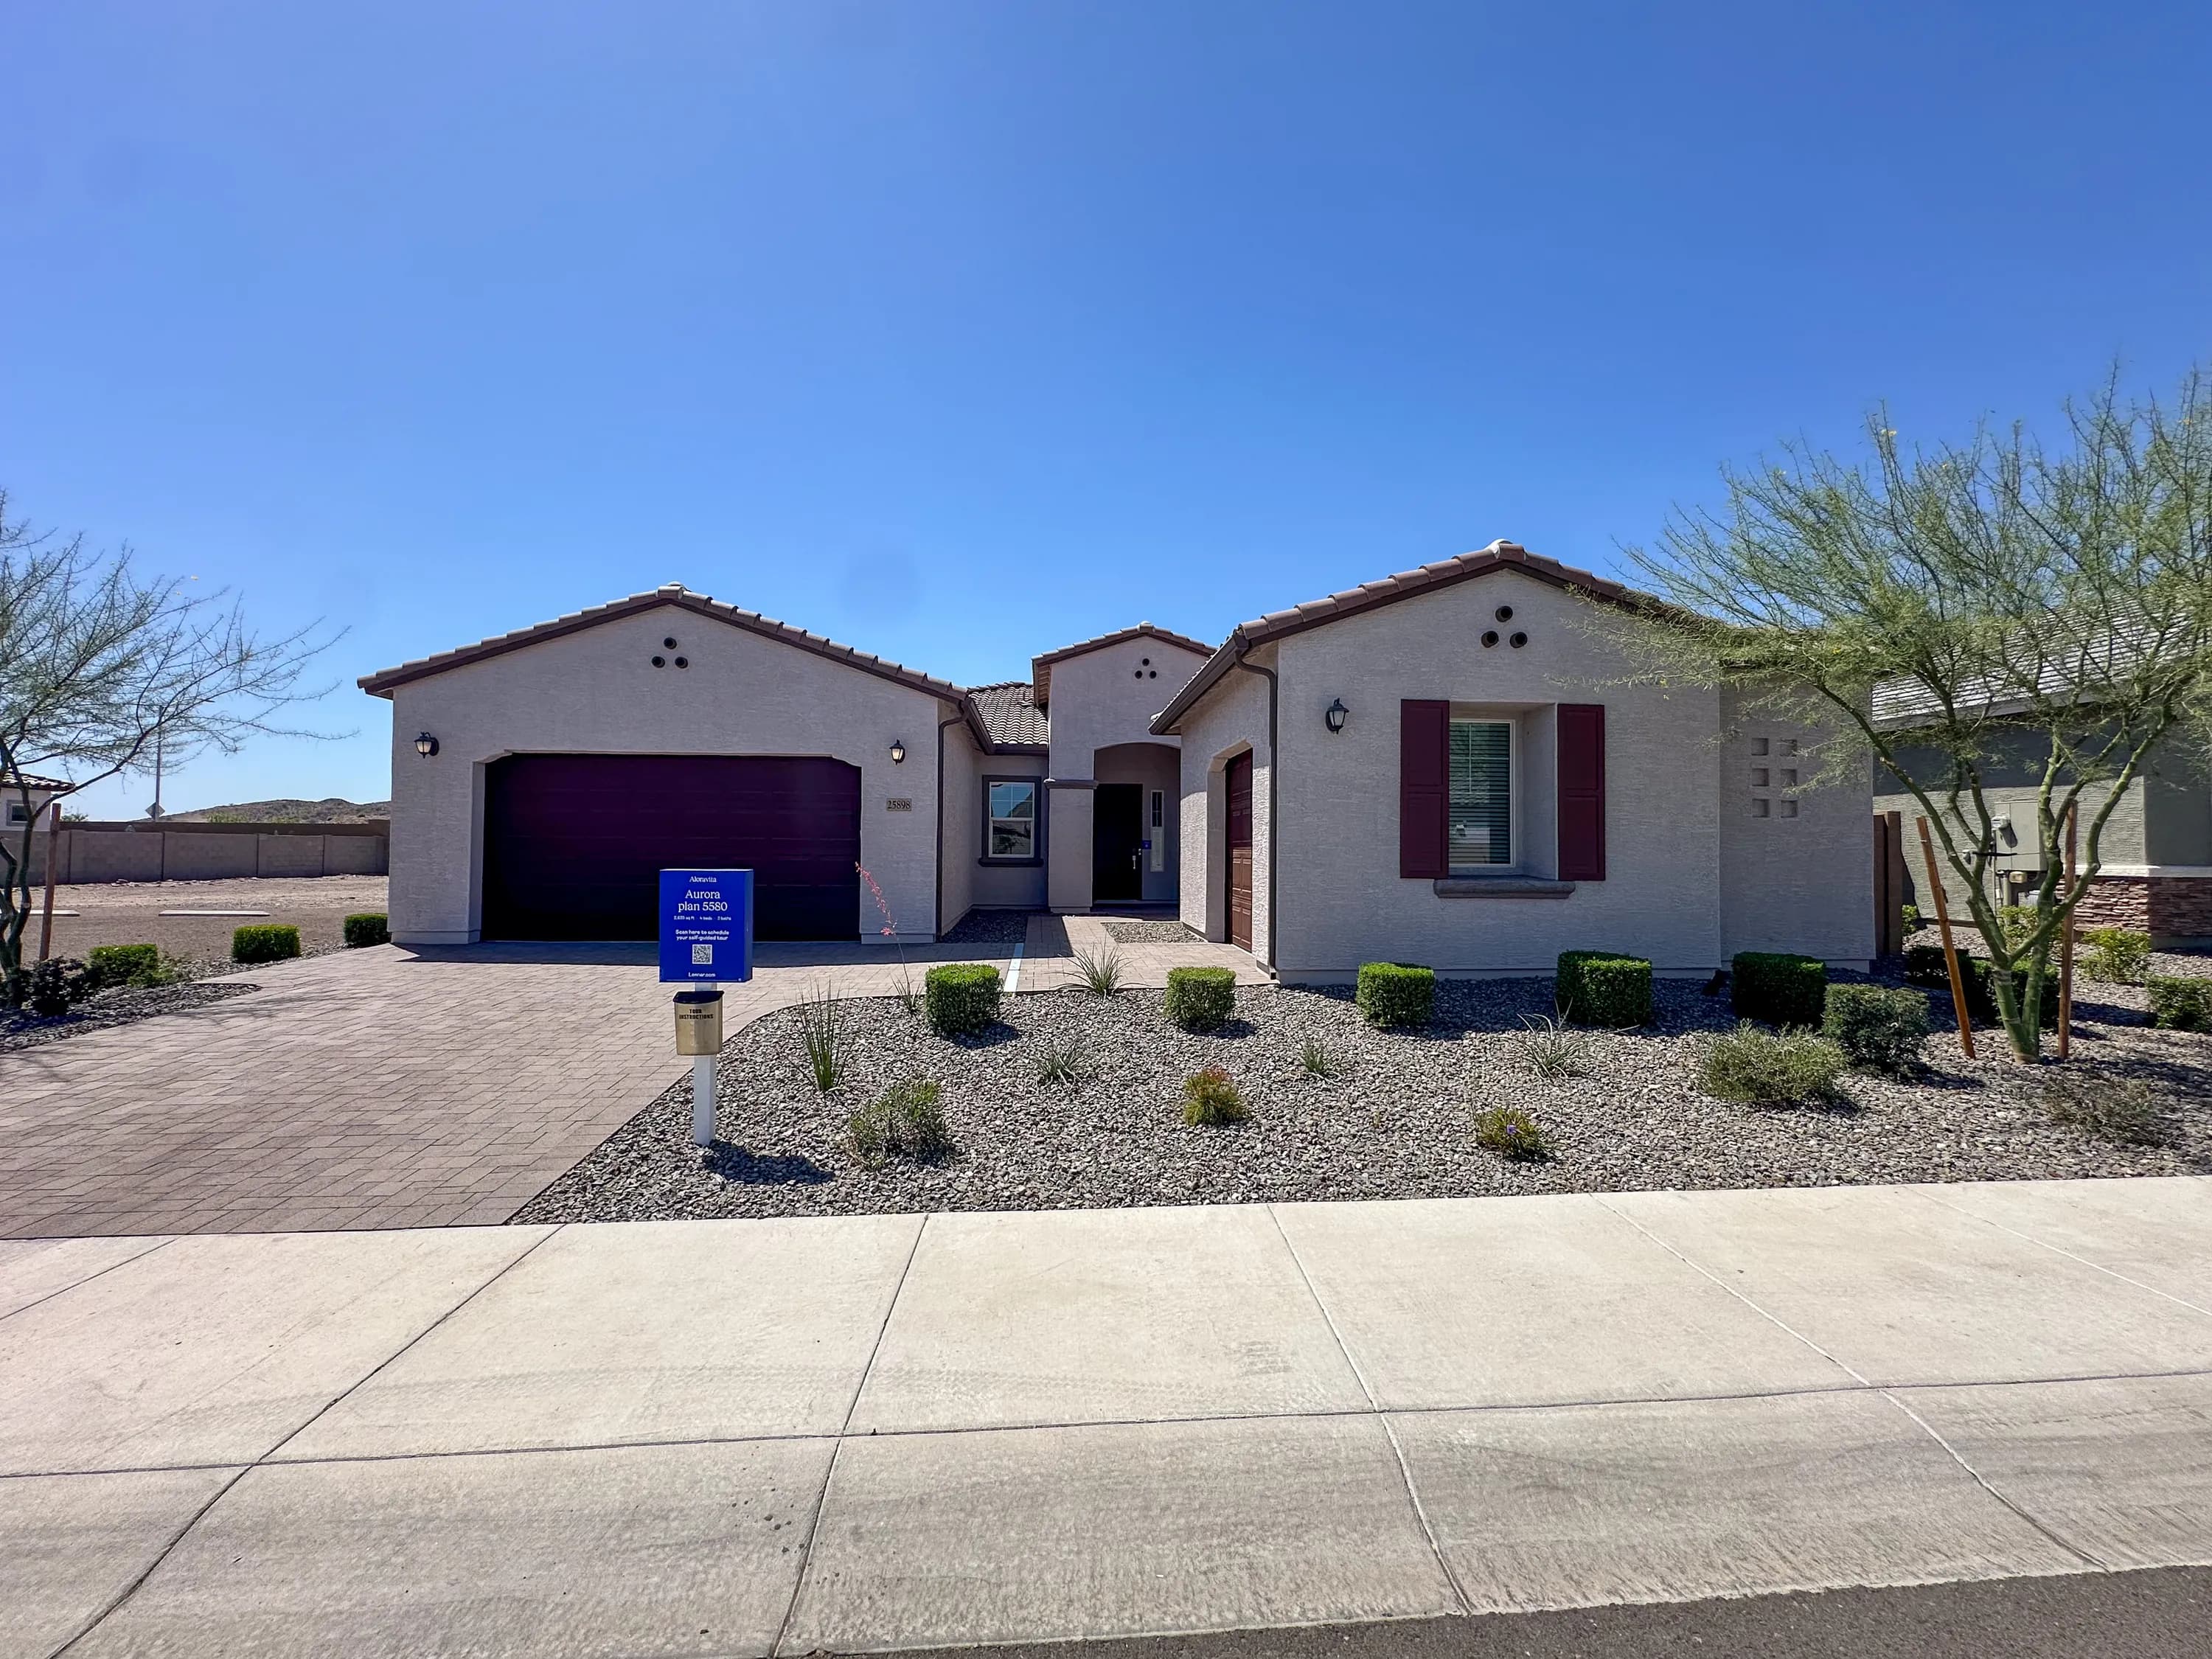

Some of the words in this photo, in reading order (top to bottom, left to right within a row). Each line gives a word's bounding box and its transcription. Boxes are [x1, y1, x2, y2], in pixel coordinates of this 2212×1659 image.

[887, 800, 911, 809] 25898
[685, 889, 720, 899] Aurora
[678, 901, 700, 913] plan
[702, 902, 728, 911] 5580
